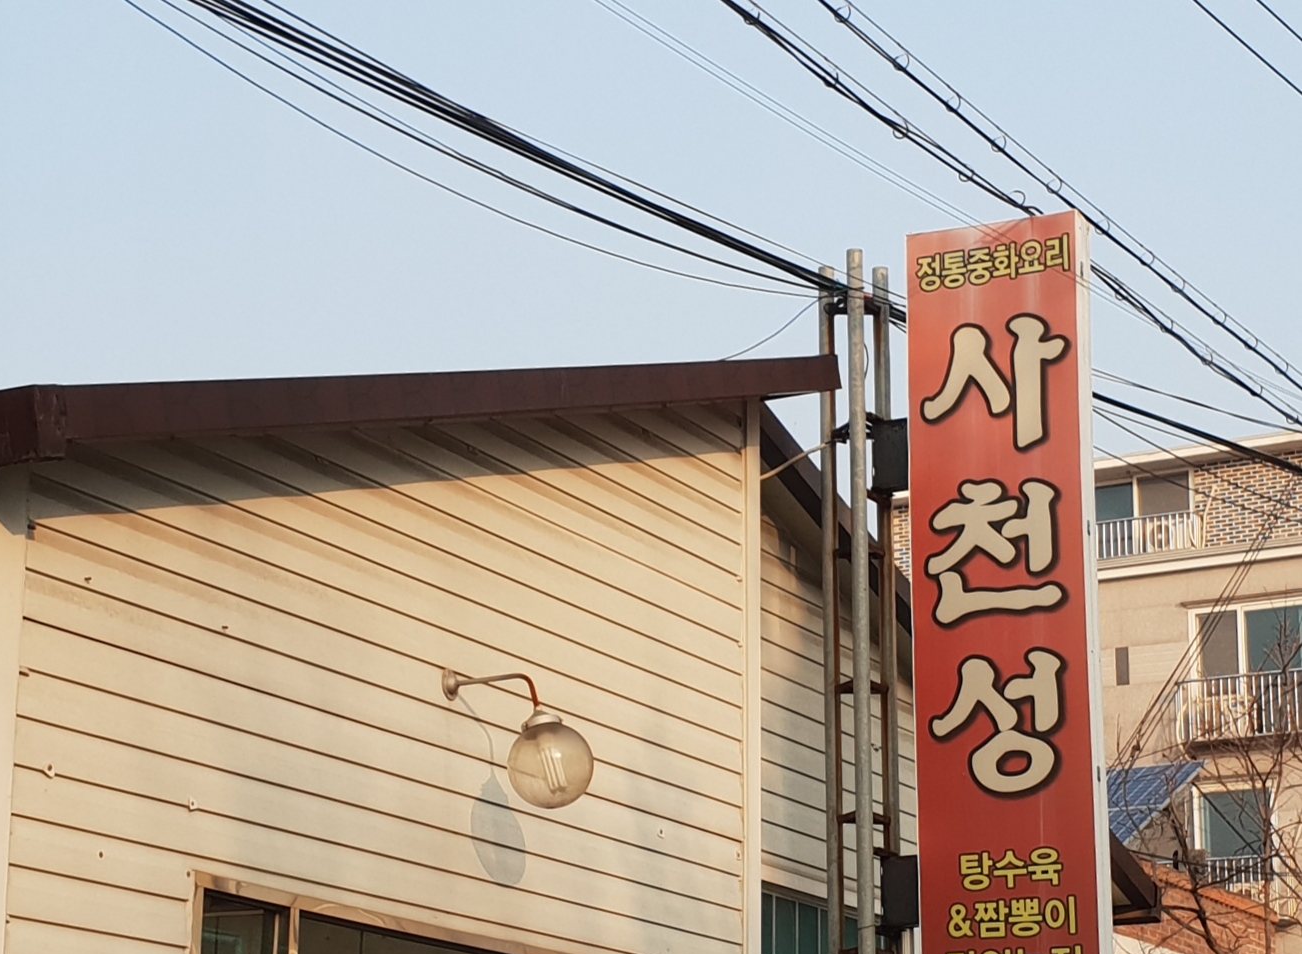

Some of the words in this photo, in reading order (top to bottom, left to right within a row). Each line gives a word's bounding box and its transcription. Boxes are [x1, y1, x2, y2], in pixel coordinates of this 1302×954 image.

[915, 233, 1071, 292] 정통중화요리
[920, 313, 1071, 798] 사천성
[958, 846, 1063, 891] 탕수육
[947, 895, 1078, 939] &짬뽕이
